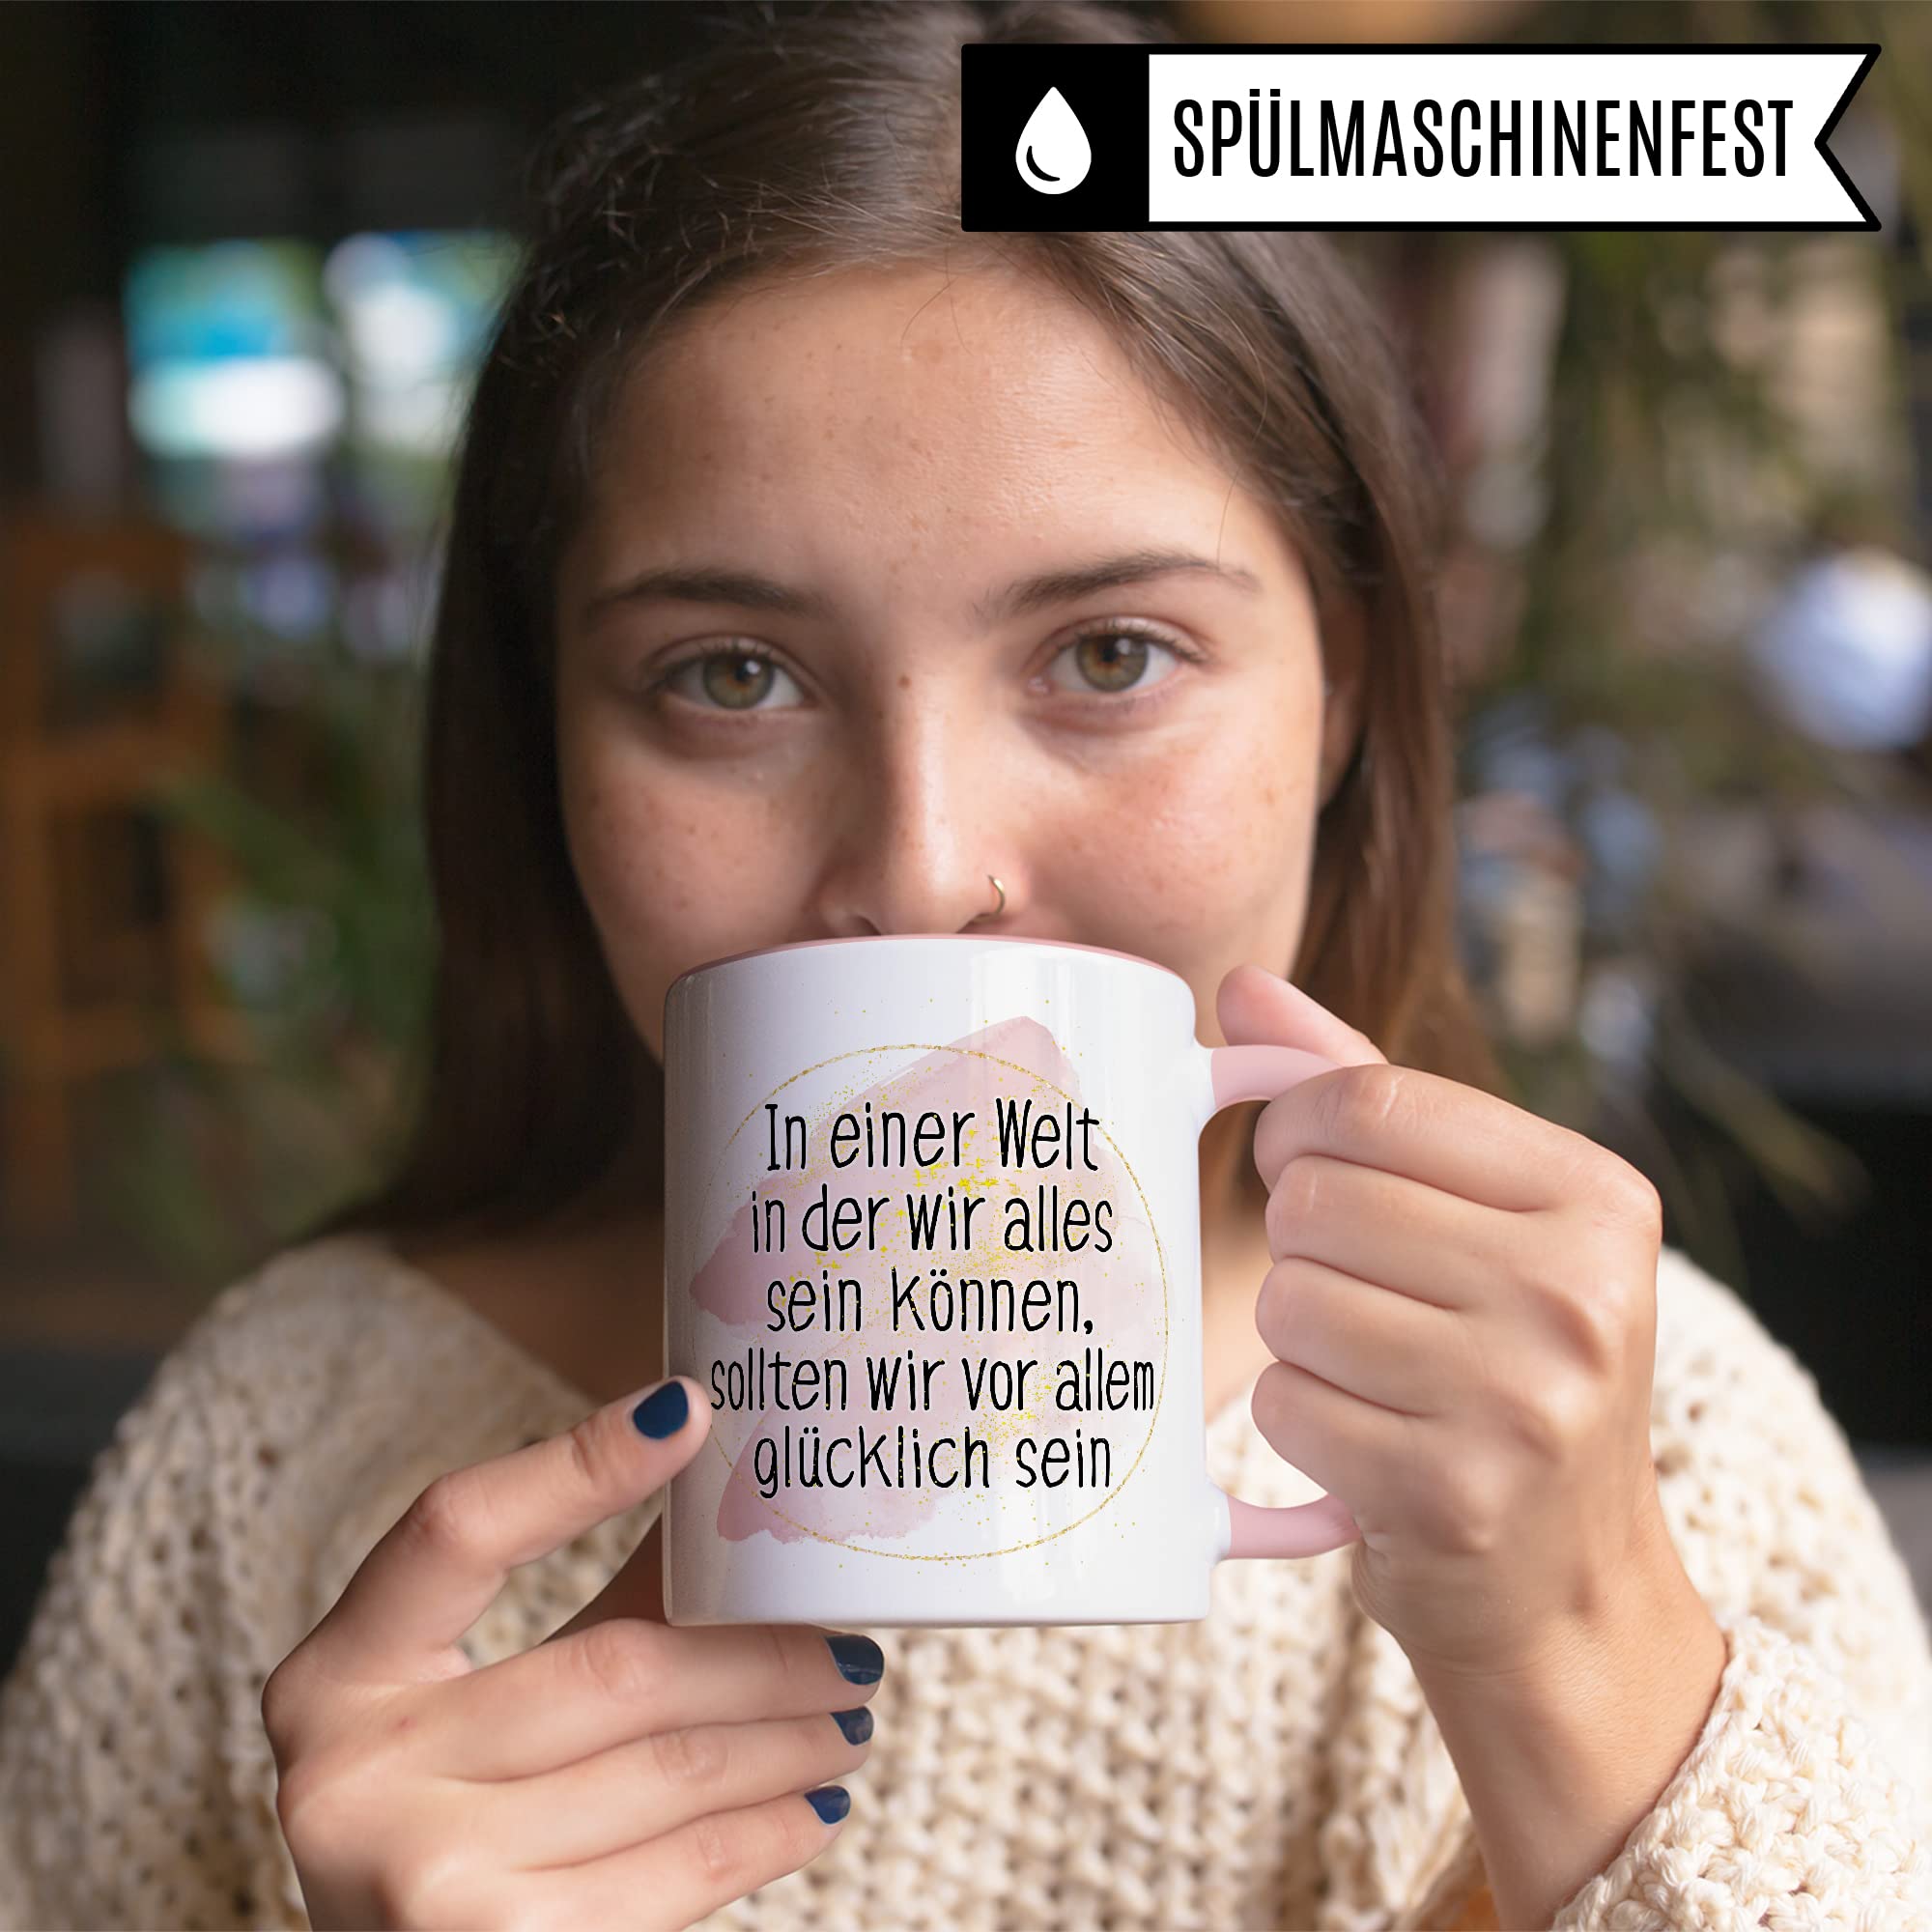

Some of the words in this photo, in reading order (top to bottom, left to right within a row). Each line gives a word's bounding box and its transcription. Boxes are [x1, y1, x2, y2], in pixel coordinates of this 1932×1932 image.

[764, 1103, 807, 1172] In
[830, 1101, 976, 1169] einer
[995, 1097, 1100, 1172] Welt
[752, 1190, 785, 1254] in
[801, 1182, 891, 1252] der
[906, 1184, 986, 1251] wir
[1004, 1184, 1114, 1253] alles
[766, 1267, 862, 1332] sein
[891, 1265, 1094, 1335] können,
[710, 1347, 848, 1411] sollten
[866, 1350, 946, 1411] wir
[961, 1357, 1038, 1411] vor
[1055, 1347, 1155, 1412] allem
[753, 1425, 991, 1499] glücklich
[1015, 1428, 1111, 1489] sein
